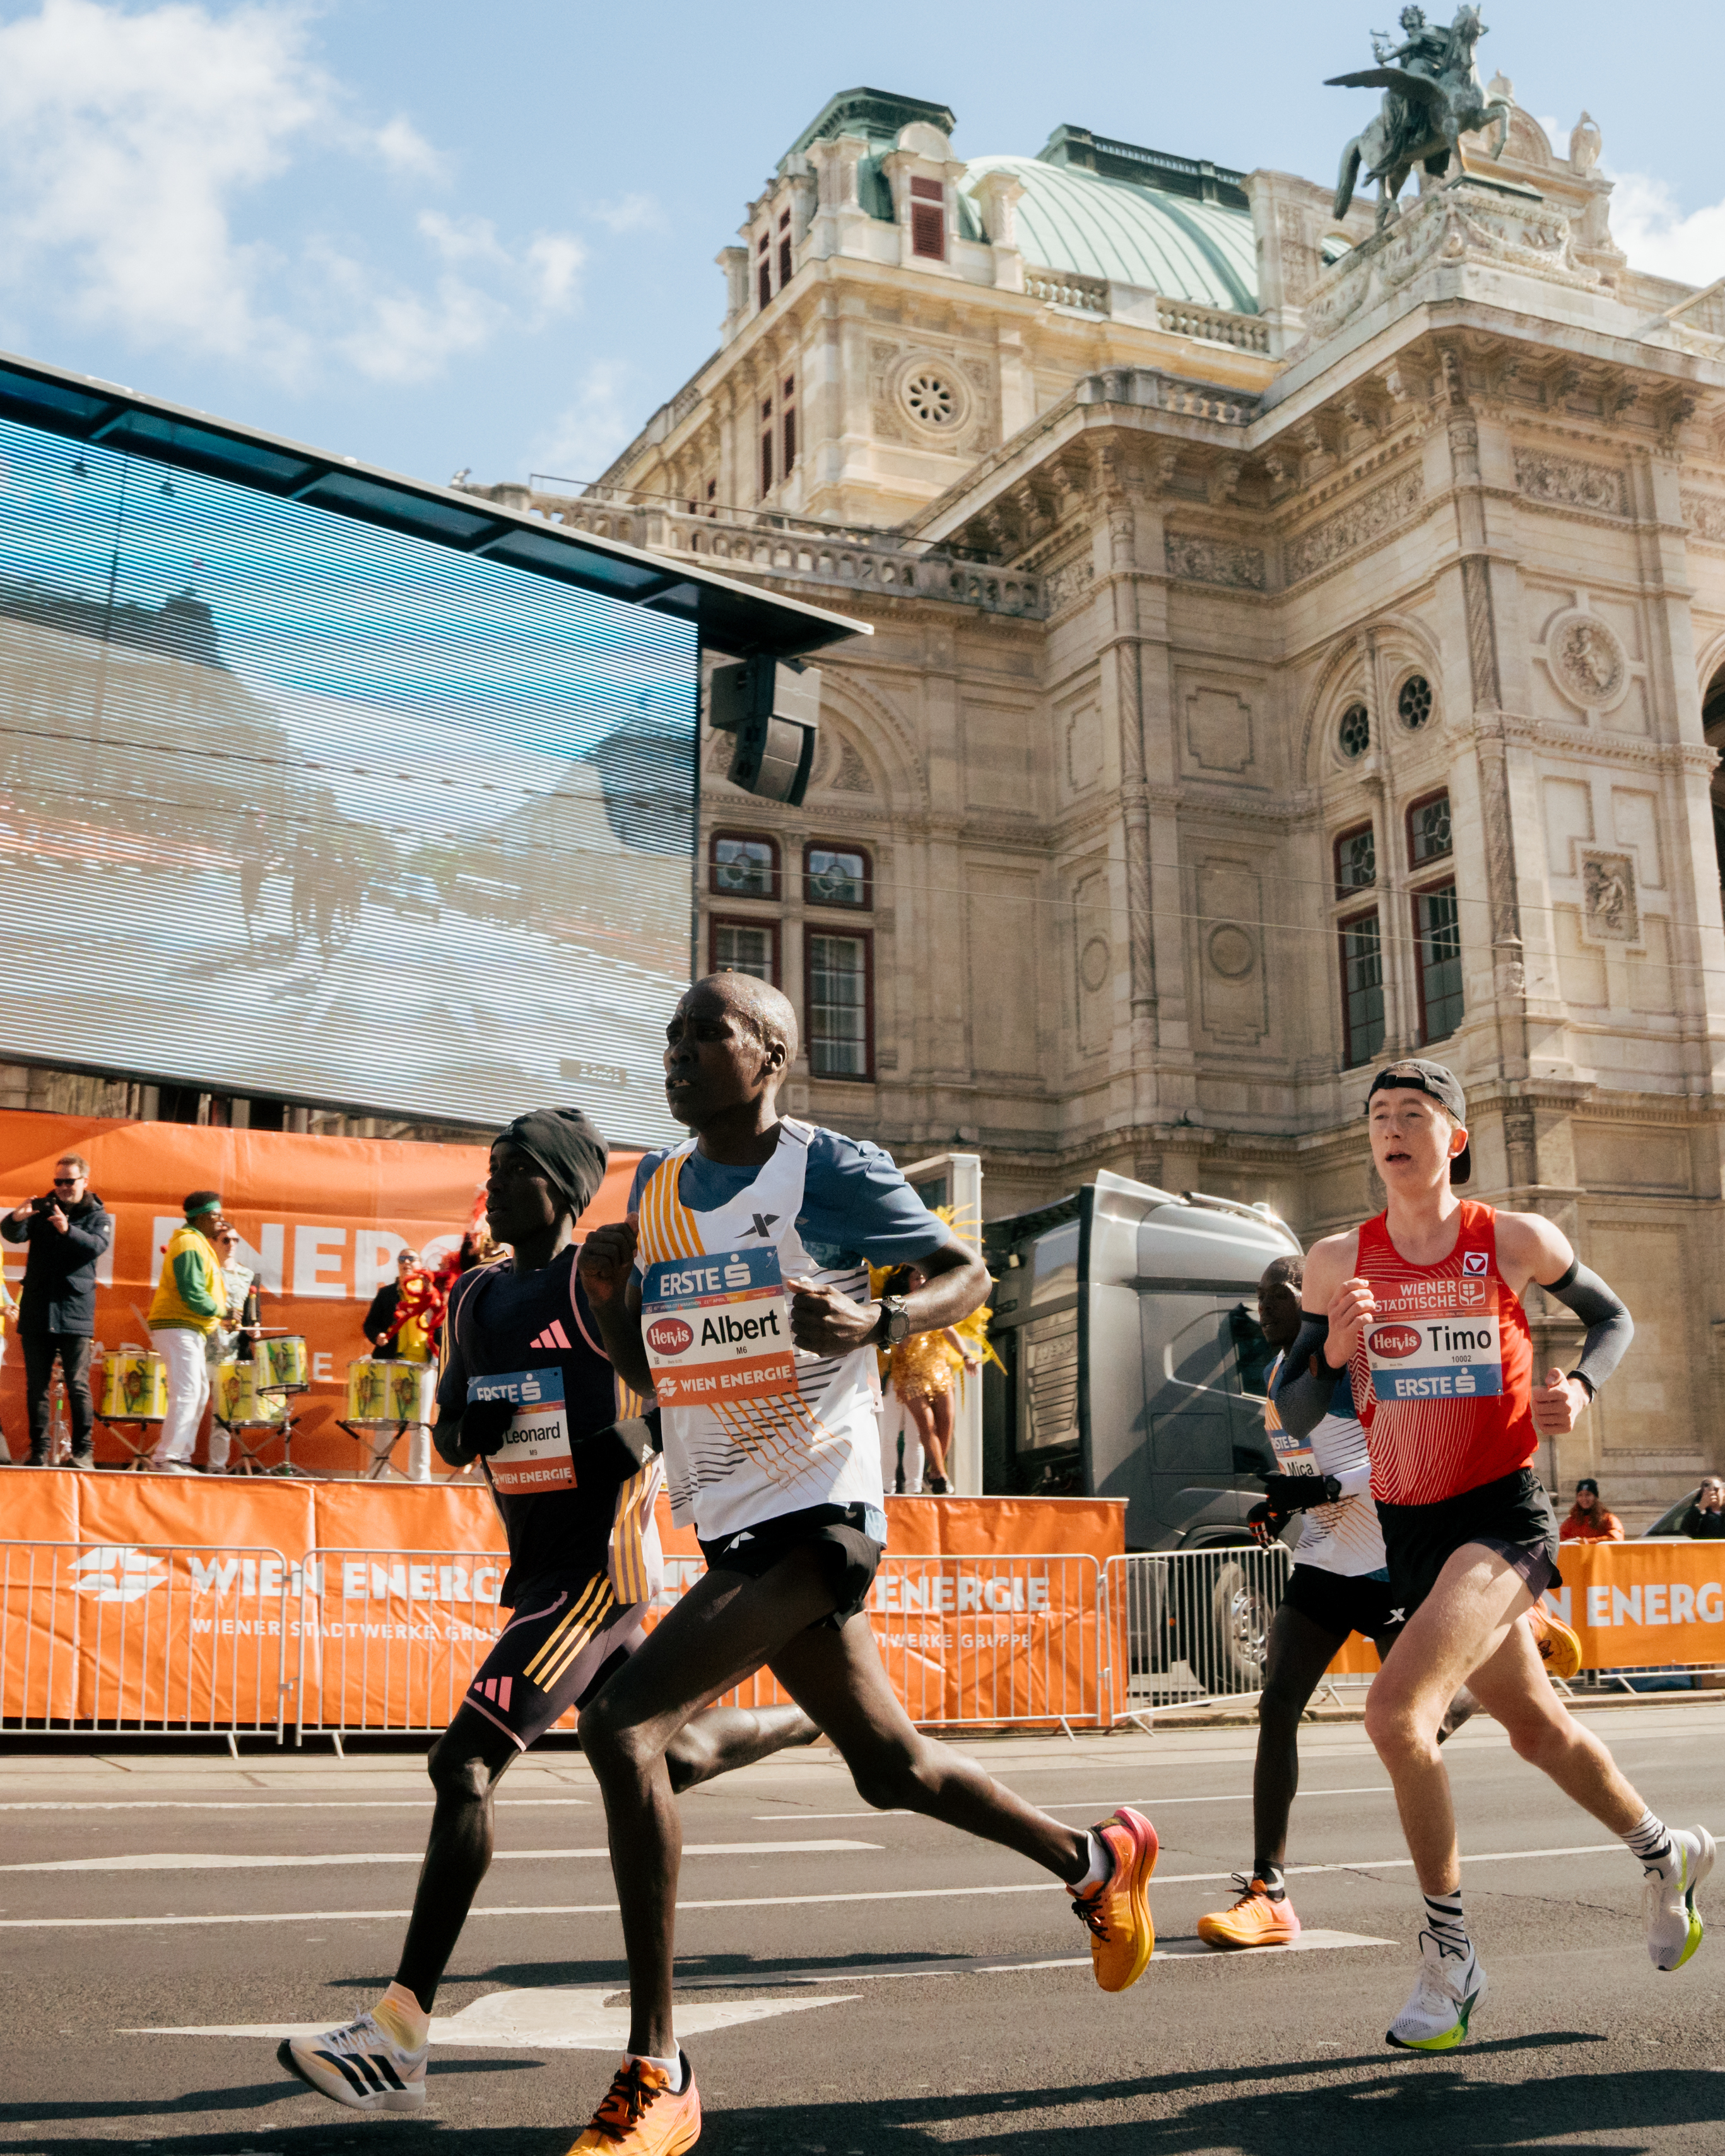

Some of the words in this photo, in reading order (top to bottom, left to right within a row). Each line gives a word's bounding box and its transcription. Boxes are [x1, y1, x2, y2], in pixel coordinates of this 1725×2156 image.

[660, 1267, 721, 1297] ERSTE
[1400, 1280, 1456, 1296] WIENER
[1375, 1295, 1457, 1312] STÄDTISCHE
[651, 1327, 690, 1347] Hervis
[701, 1309, 780, 1346] Albert
[1374, 1333, 1418, 1351] Hervis
[1427, 1326, 1492, 1352] Timo
[736, 1346, 748, 1355] M6
[1451, 1355, 1471, 1364] 10002
[680, 1377, 717, 1393] WIEN
[721, 1365, 792, 1389] ENERGIE
[1395, 1376, 1452, 1396] ERSTE
[477, 1384, 519, 1403] ERSTE
[505, 1422, 560, 1444] Leonard
[498, 1473, 518, 1484] WIEN
[519, 1467, 572, 1483] ENERGIE
[1287, 1461, 1314, 1476] Mica
[187, 1557, 326, 1599] WIEN
[343, 1562, 509, 1603] ENERG
[875, 1575, 1051, 1612] ENERGIE
[1587, 1582, 1725, 1627] ENERG
[192, 1618, 281, 1635] WIENER
[290, 1621, 436, 1641] STADTWERKE
[962, 1634, 1031, 1649] GRUPPE
